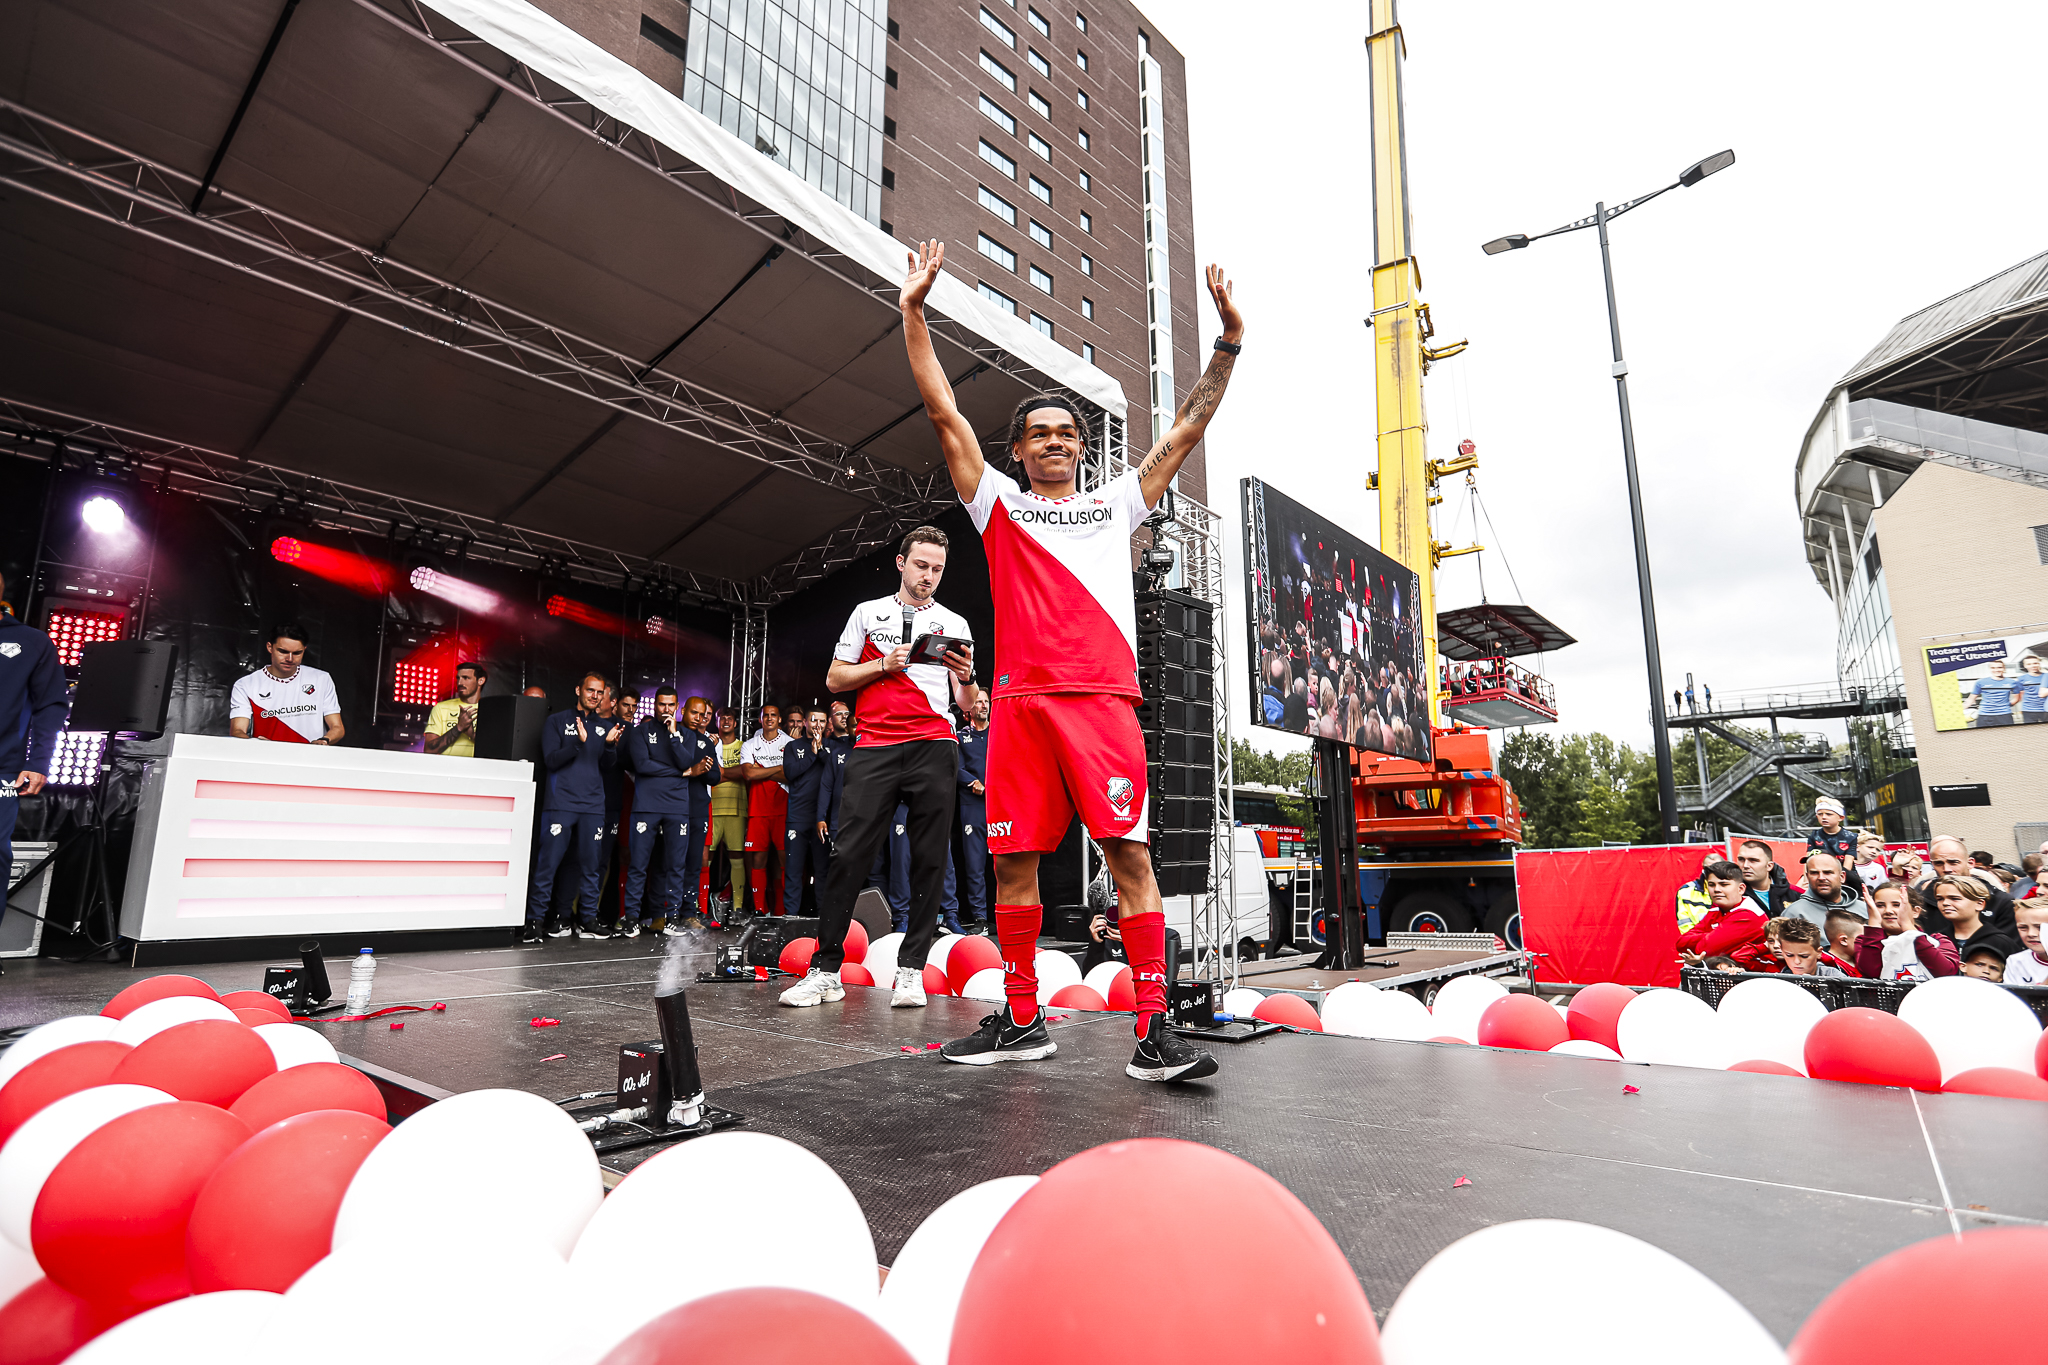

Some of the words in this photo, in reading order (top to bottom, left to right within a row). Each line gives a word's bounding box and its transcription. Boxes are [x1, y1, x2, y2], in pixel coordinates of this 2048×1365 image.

[1138, 441, 1174, 481] ELIEVE
[1010, 507, 1112, 525] CONCLUSION
[1927, 646, 1960, 657] Trotse
[1961, 643, 2002, 654] partner
[1929, 655, 1950, 664] van
[1950, 654, 1965, 662] FC
[1965, 650, 2007, 661] Utrecht
[261, 704, 317, 719] CONCLUSION
[283, 978, 298, 990] Jet
[1193, 993, 1207, 1006] Jet
[637, 1070, 652, 1088] Jet
